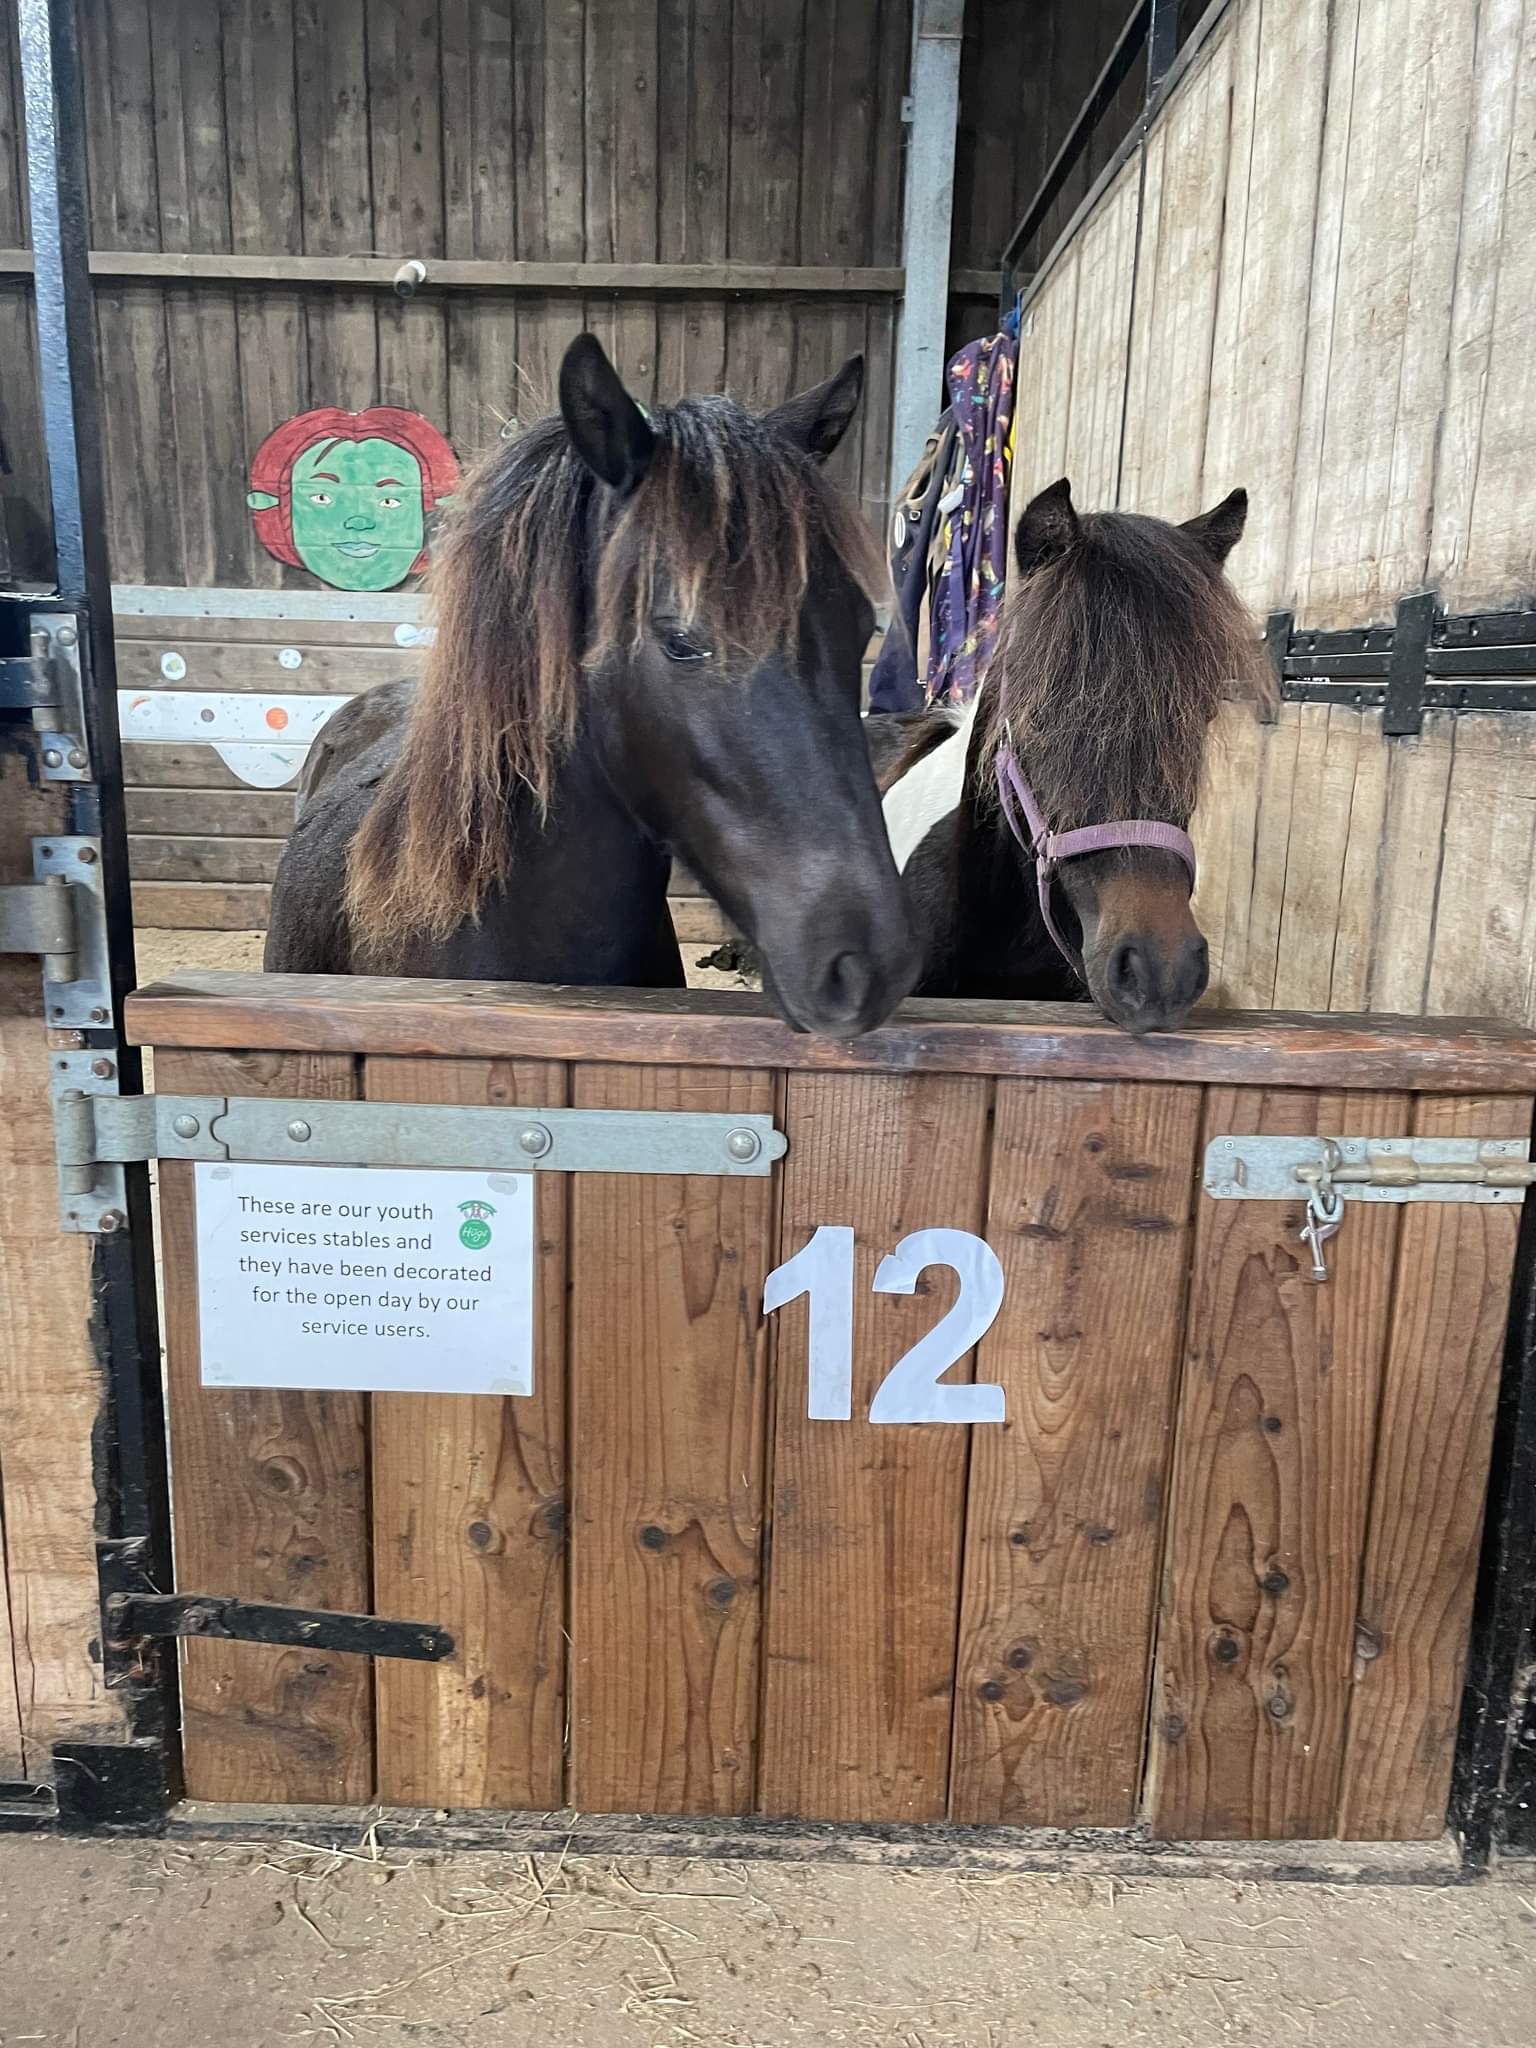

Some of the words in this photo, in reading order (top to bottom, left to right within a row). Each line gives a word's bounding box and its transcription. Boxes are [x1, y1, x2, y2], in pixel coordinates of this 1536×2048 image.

[237, 1195, 295, 1215] These
[301, 1203, 332, 1217] are
[338, 1204, 372, 1218] our
[376, 1203, 433, 1223] youth
[240, 1227, 317, 1246] services
[323, 1230, 390, 1249] stables
[396, 1233, 432, 1250] and
[239, 1255, 282, 1277] they
[288, 1257, 334, 1276] have
[340, 1259, 387, 1278] been
[393, 1262, 492, 1282] decorated
[252, 1285, 281, 1303] for
[285, 1287, 318, 1305] the
[323, 1293, 372, 1310] open
[378, 1290, 412, 1312] day
[418, 1292, 441, 1313] by
[446, 1297, 480, 1311] our
[301, 1319, 368, 1336] service
[375, 1324, 430, 1338] users.
[763, 1226, 1006, 1423] 12
